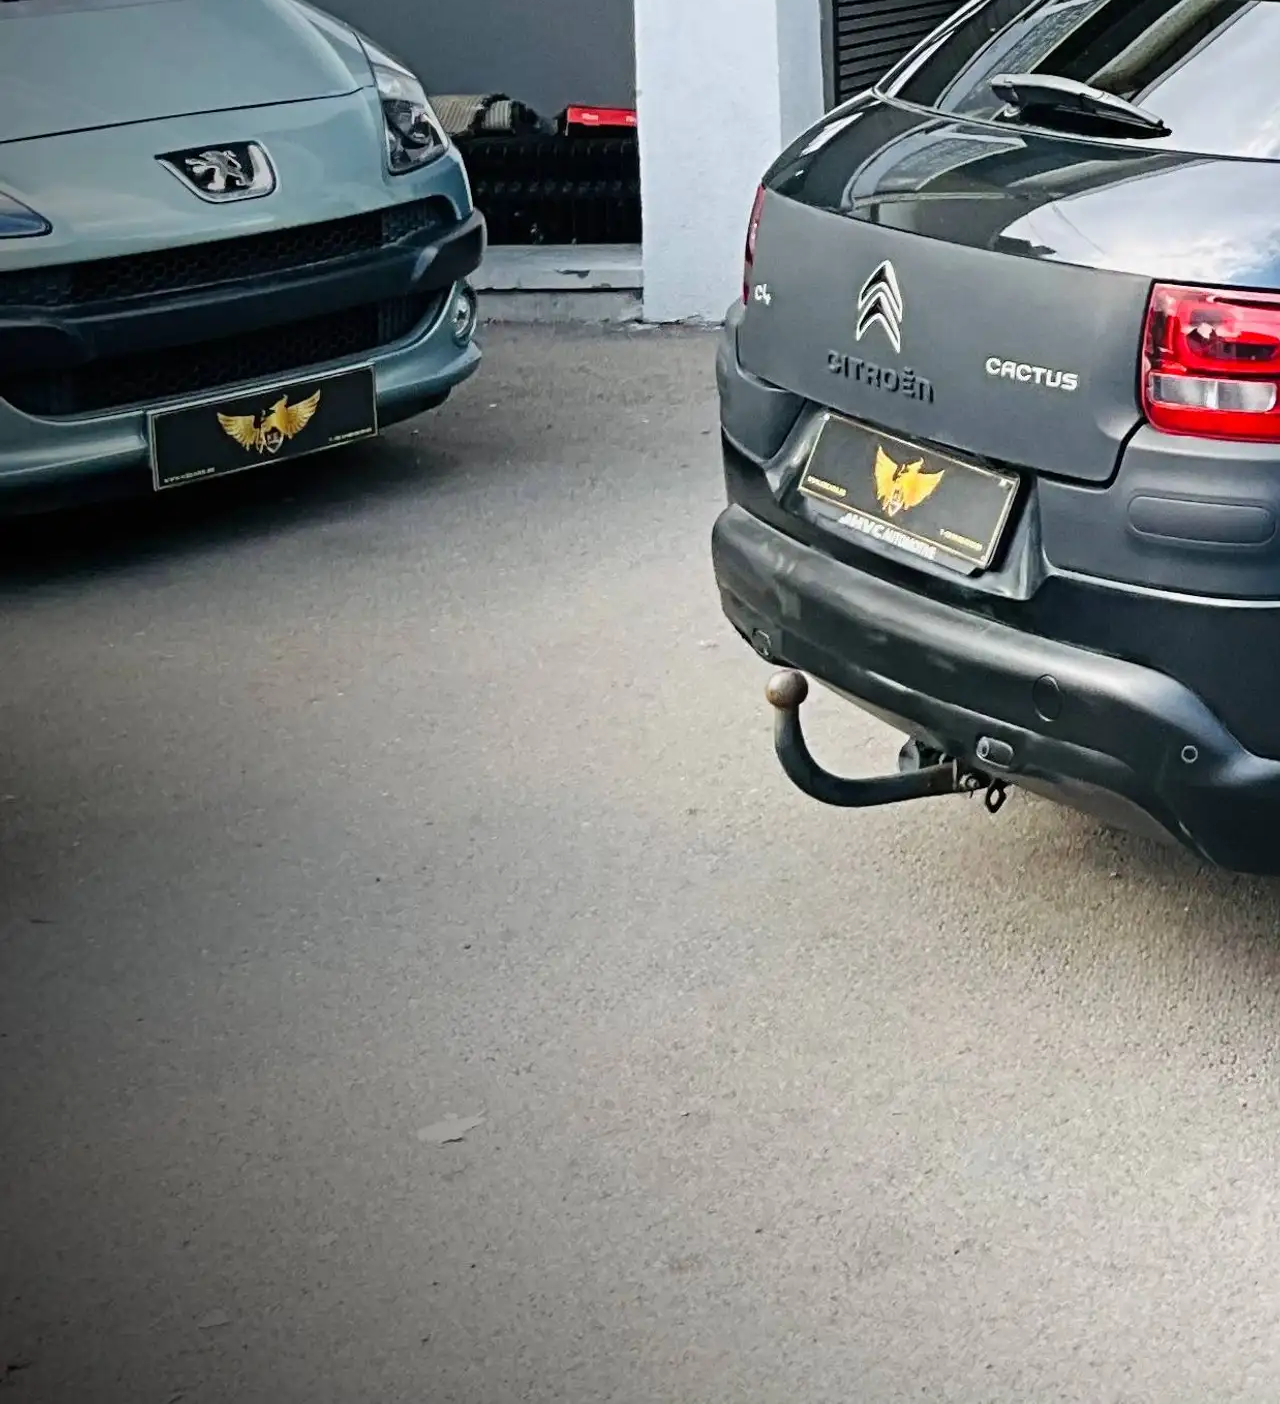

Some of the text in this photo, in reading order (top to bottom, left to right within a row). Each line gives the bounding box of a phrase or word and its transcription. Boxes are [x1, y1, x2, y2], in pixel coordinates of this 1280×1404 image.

[754, 283, 772, 306] C4
[827, 349, 936, 405] CITROËN
[985, 355, 1080, 393] CACTUS
